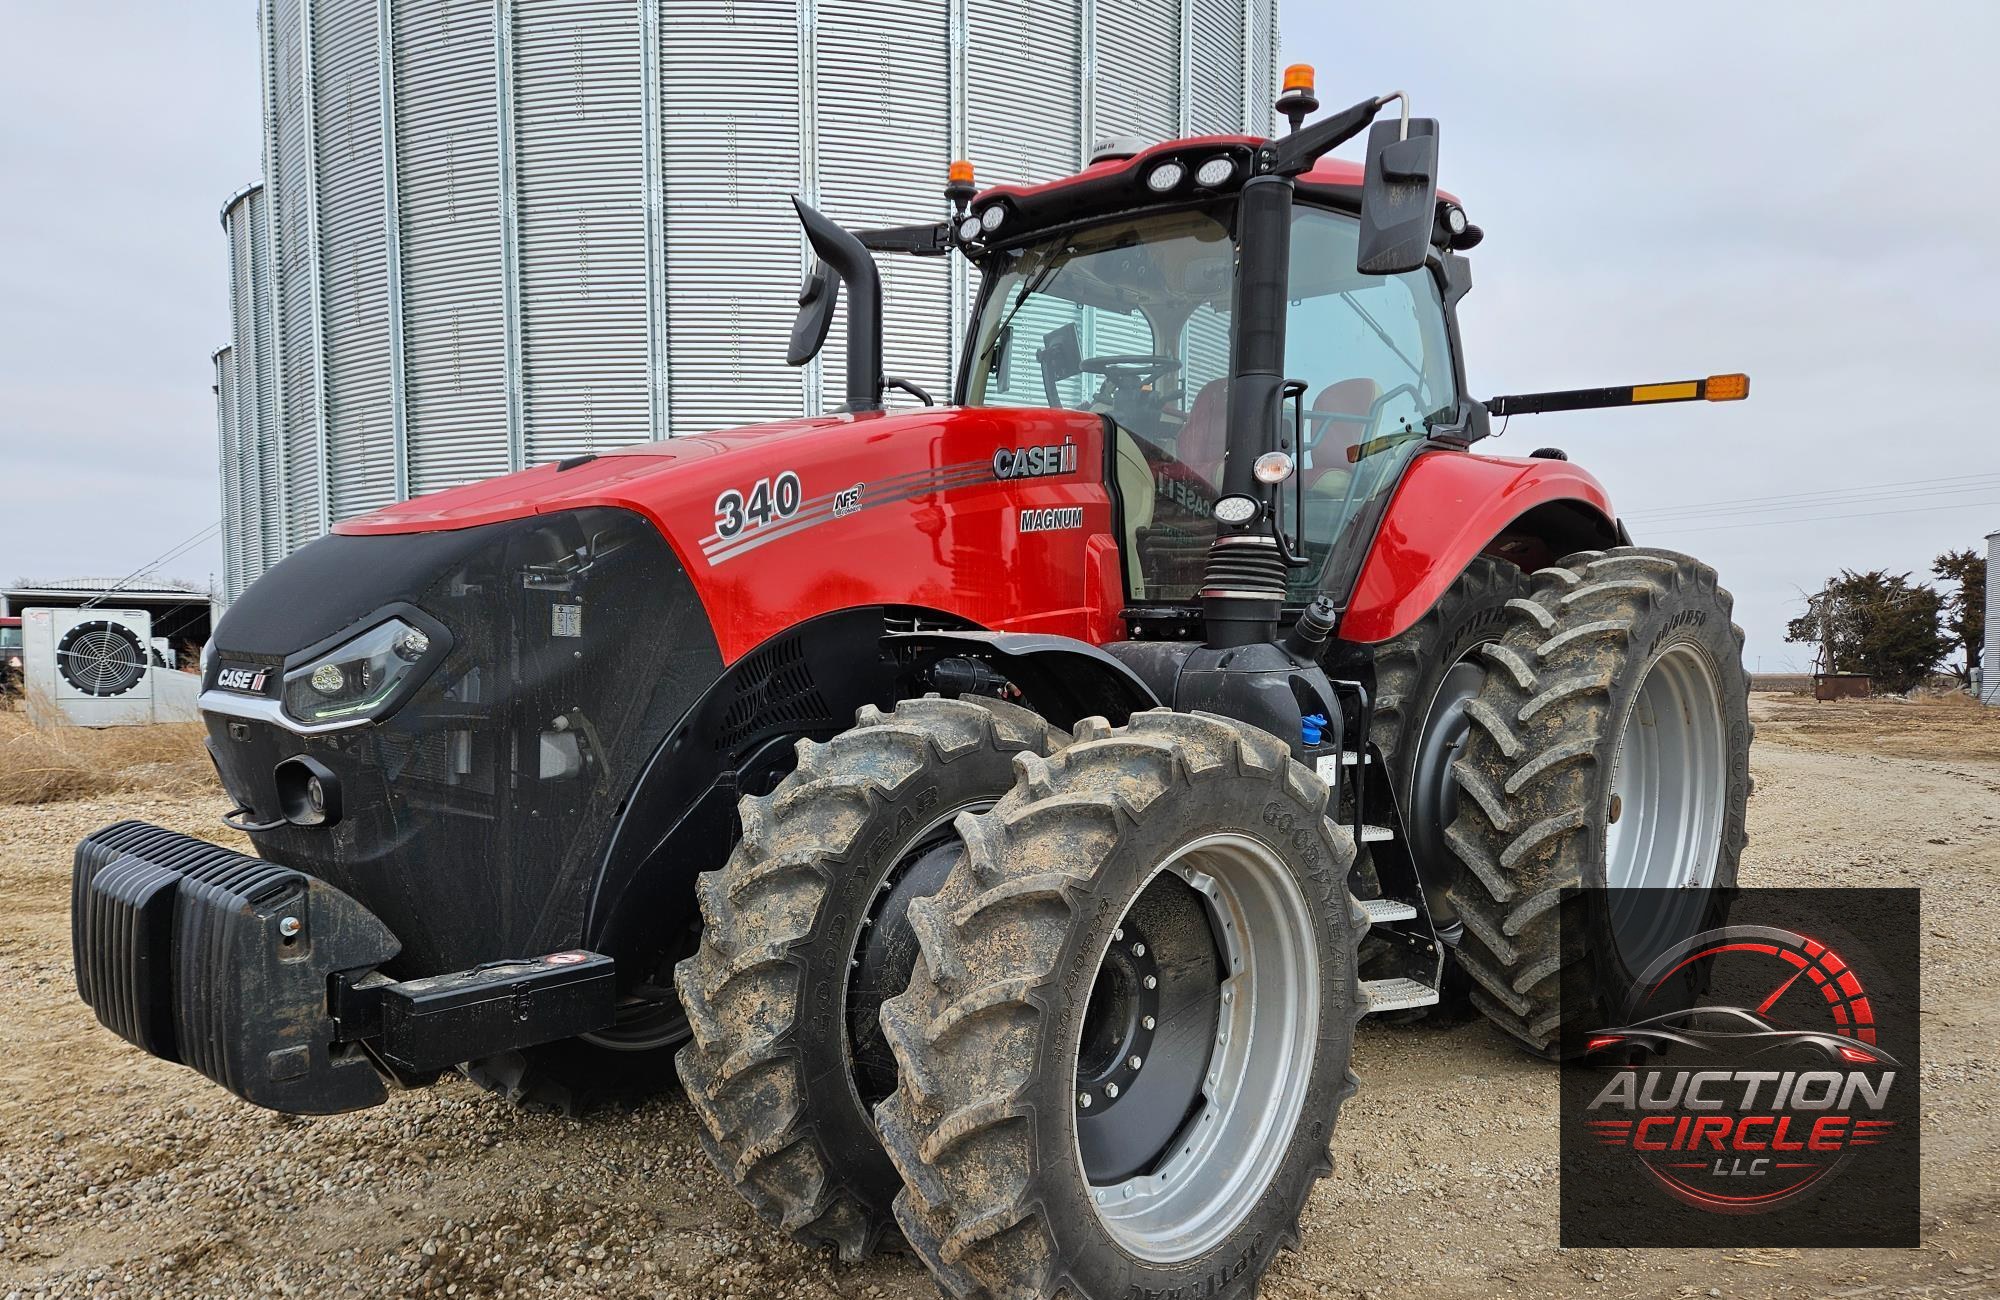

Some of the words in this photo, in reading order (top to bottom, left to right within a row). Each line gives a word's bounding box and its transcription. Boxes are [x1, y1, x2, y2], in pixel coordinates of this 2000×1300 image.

[993, 447, 1059, 480] CASE
[715, 471, 801, 540] 340
[833, 489, 858, 511] AFS
[1020, 507, 1083, 533] MAGNUM
[217, 669, 252, 689] CASE
[1263, 802, 1347, 1010] GOODYEAR
